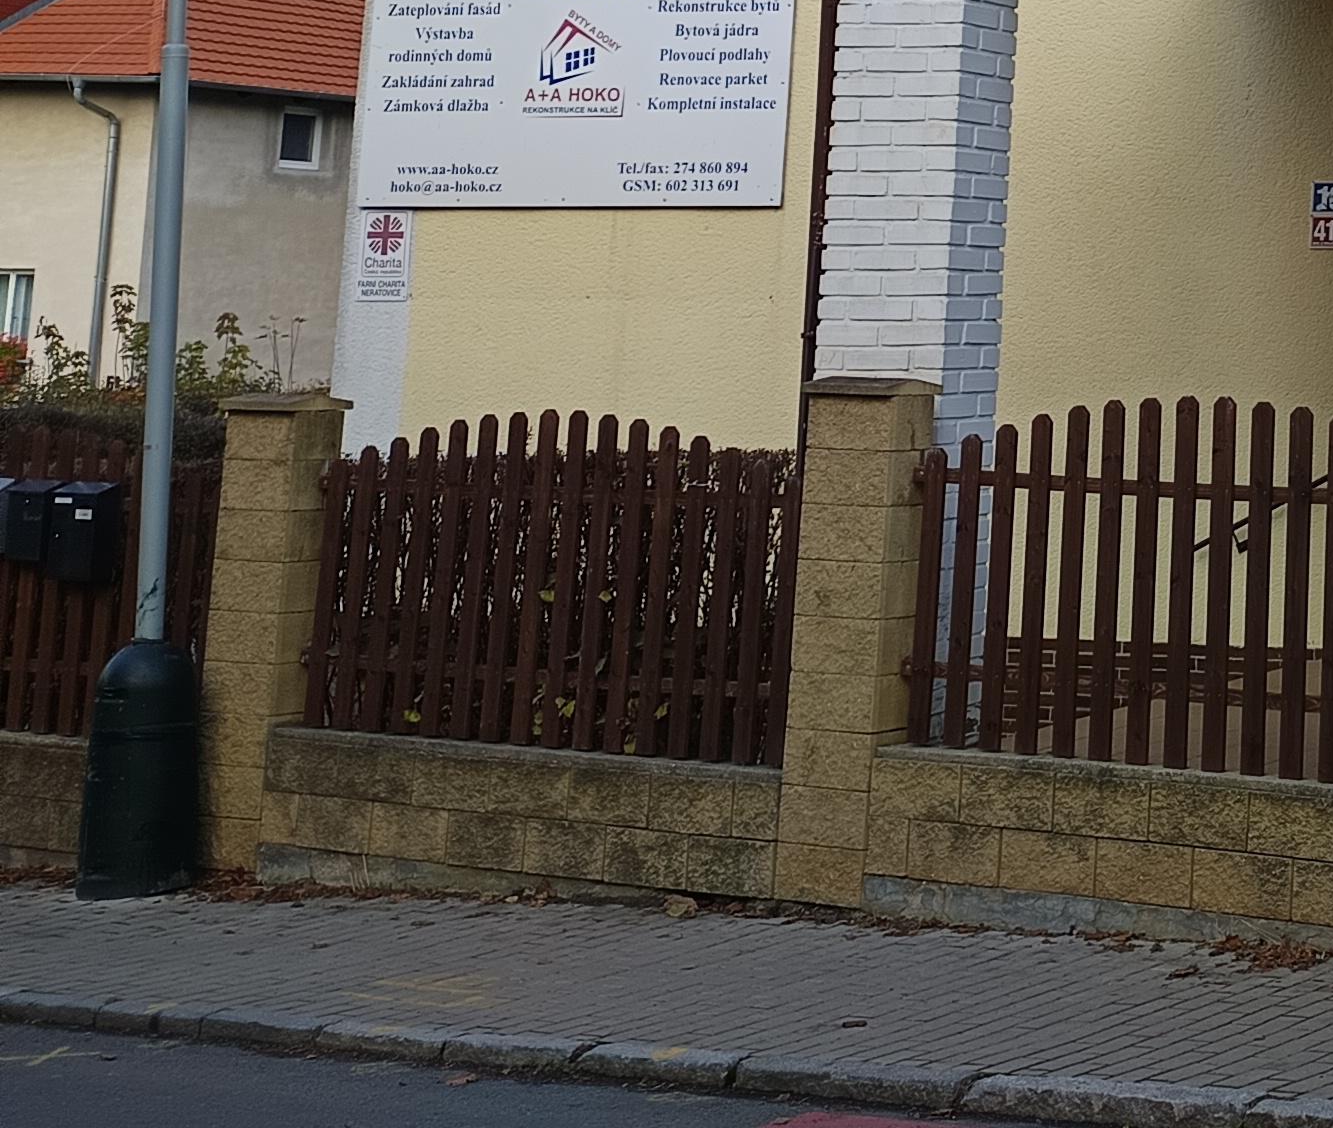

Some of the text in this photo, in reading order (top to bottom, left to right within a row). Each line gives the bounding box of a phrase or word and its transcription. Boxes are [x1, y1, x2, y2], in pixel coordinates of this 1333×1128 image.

[388, 2, 501, 19] Zateplování fasád
[658, 0, 747, 13] Rekonstrukce
[416, 27, 474, 44] Výstavba
[568, 9, 622, 52] BYTY A DOMY
[675, 22, 759, 40] Bytová jádra
[388, 47, 492, 65] rodinných domů
[659, 48, 770, 64] Plovoucí podlahy
[381, 74, 495, 88] Zakládání zahrad
[659, 72, 768, 88] Renovace parket
[524, 87, 620, 102] A+A HOKO
[383, 98, 489, 113] Zámková dlažba
[522, 106, 585, 114] REKONSTRUKCE
[587, 106, 598, 114] NA
[647, 96, 777, 113] Kompletní instalace
[397, 163, 499, 175] www.aa-hoko.cz
[617, 161, 749, 175] Tel./fax: 274 860 894
[390, 180, 502, 195] hoko@aa-hoko.cz
[622, 179, 739, 192] GSM: 602 313 691
[364, 256, 402, 268] Charita
